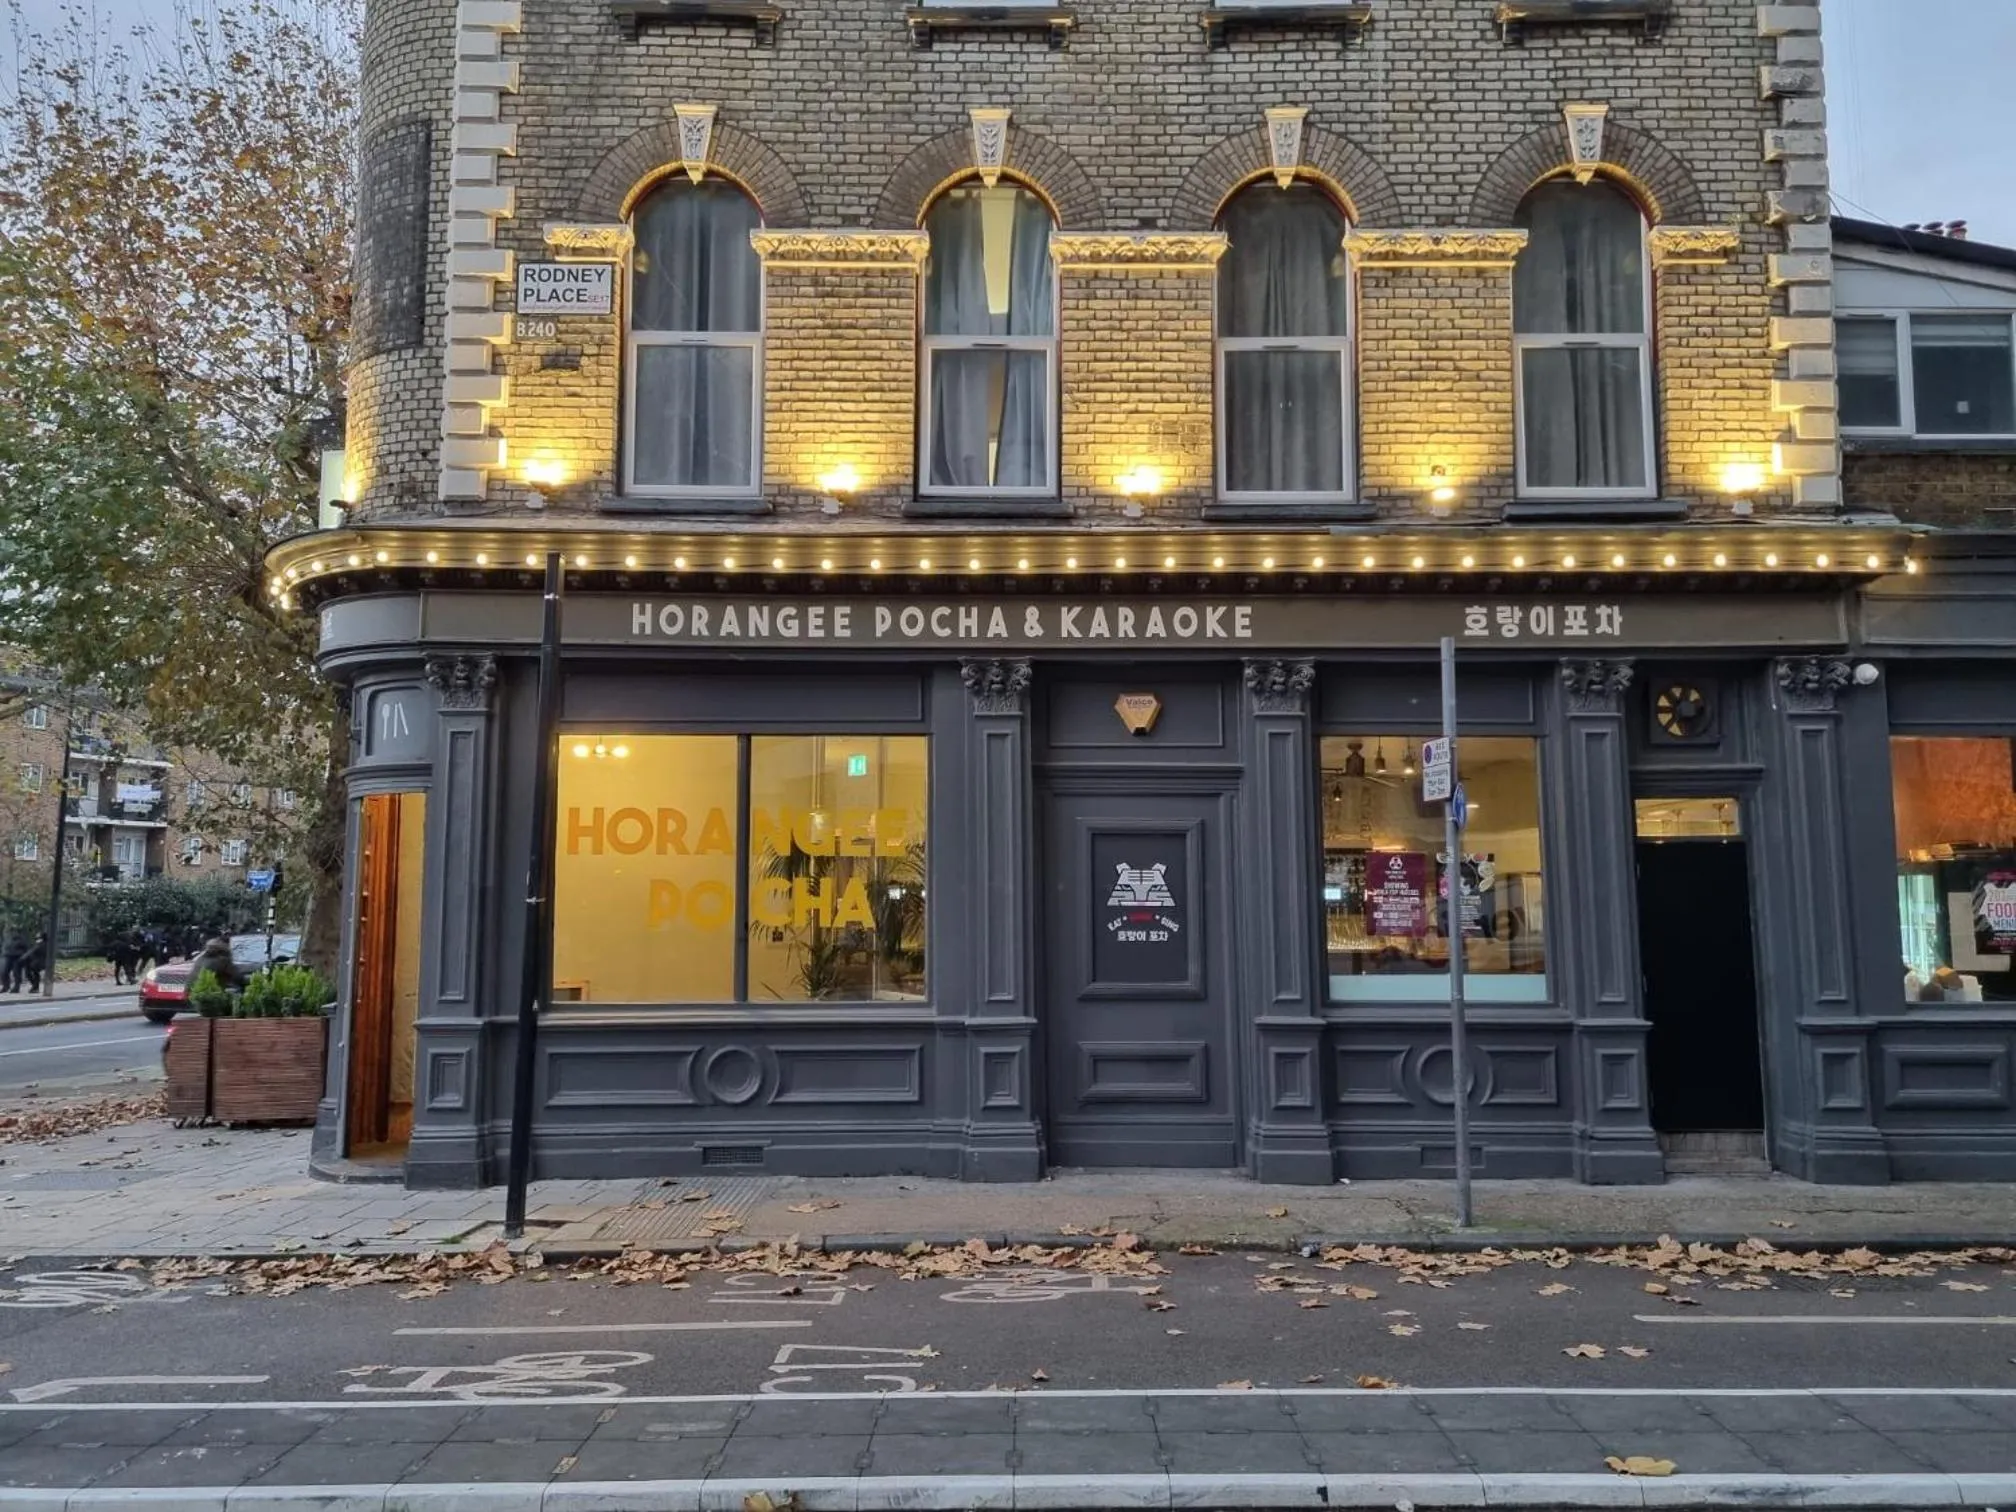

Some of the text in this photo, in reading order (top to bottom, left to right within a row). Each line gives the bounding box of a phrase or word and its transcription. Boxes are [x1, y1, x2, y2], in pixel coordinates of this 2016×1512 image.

[523, 268, 606, 283] RODNEY
[523, 288, 588, 303] PLACE
[632, 603, 1253, 638] HORANGEE POCHA & KARAOKE
[565, 807, 905, 857] HORANGEE
[649, 876, 876, 931] POCHA
